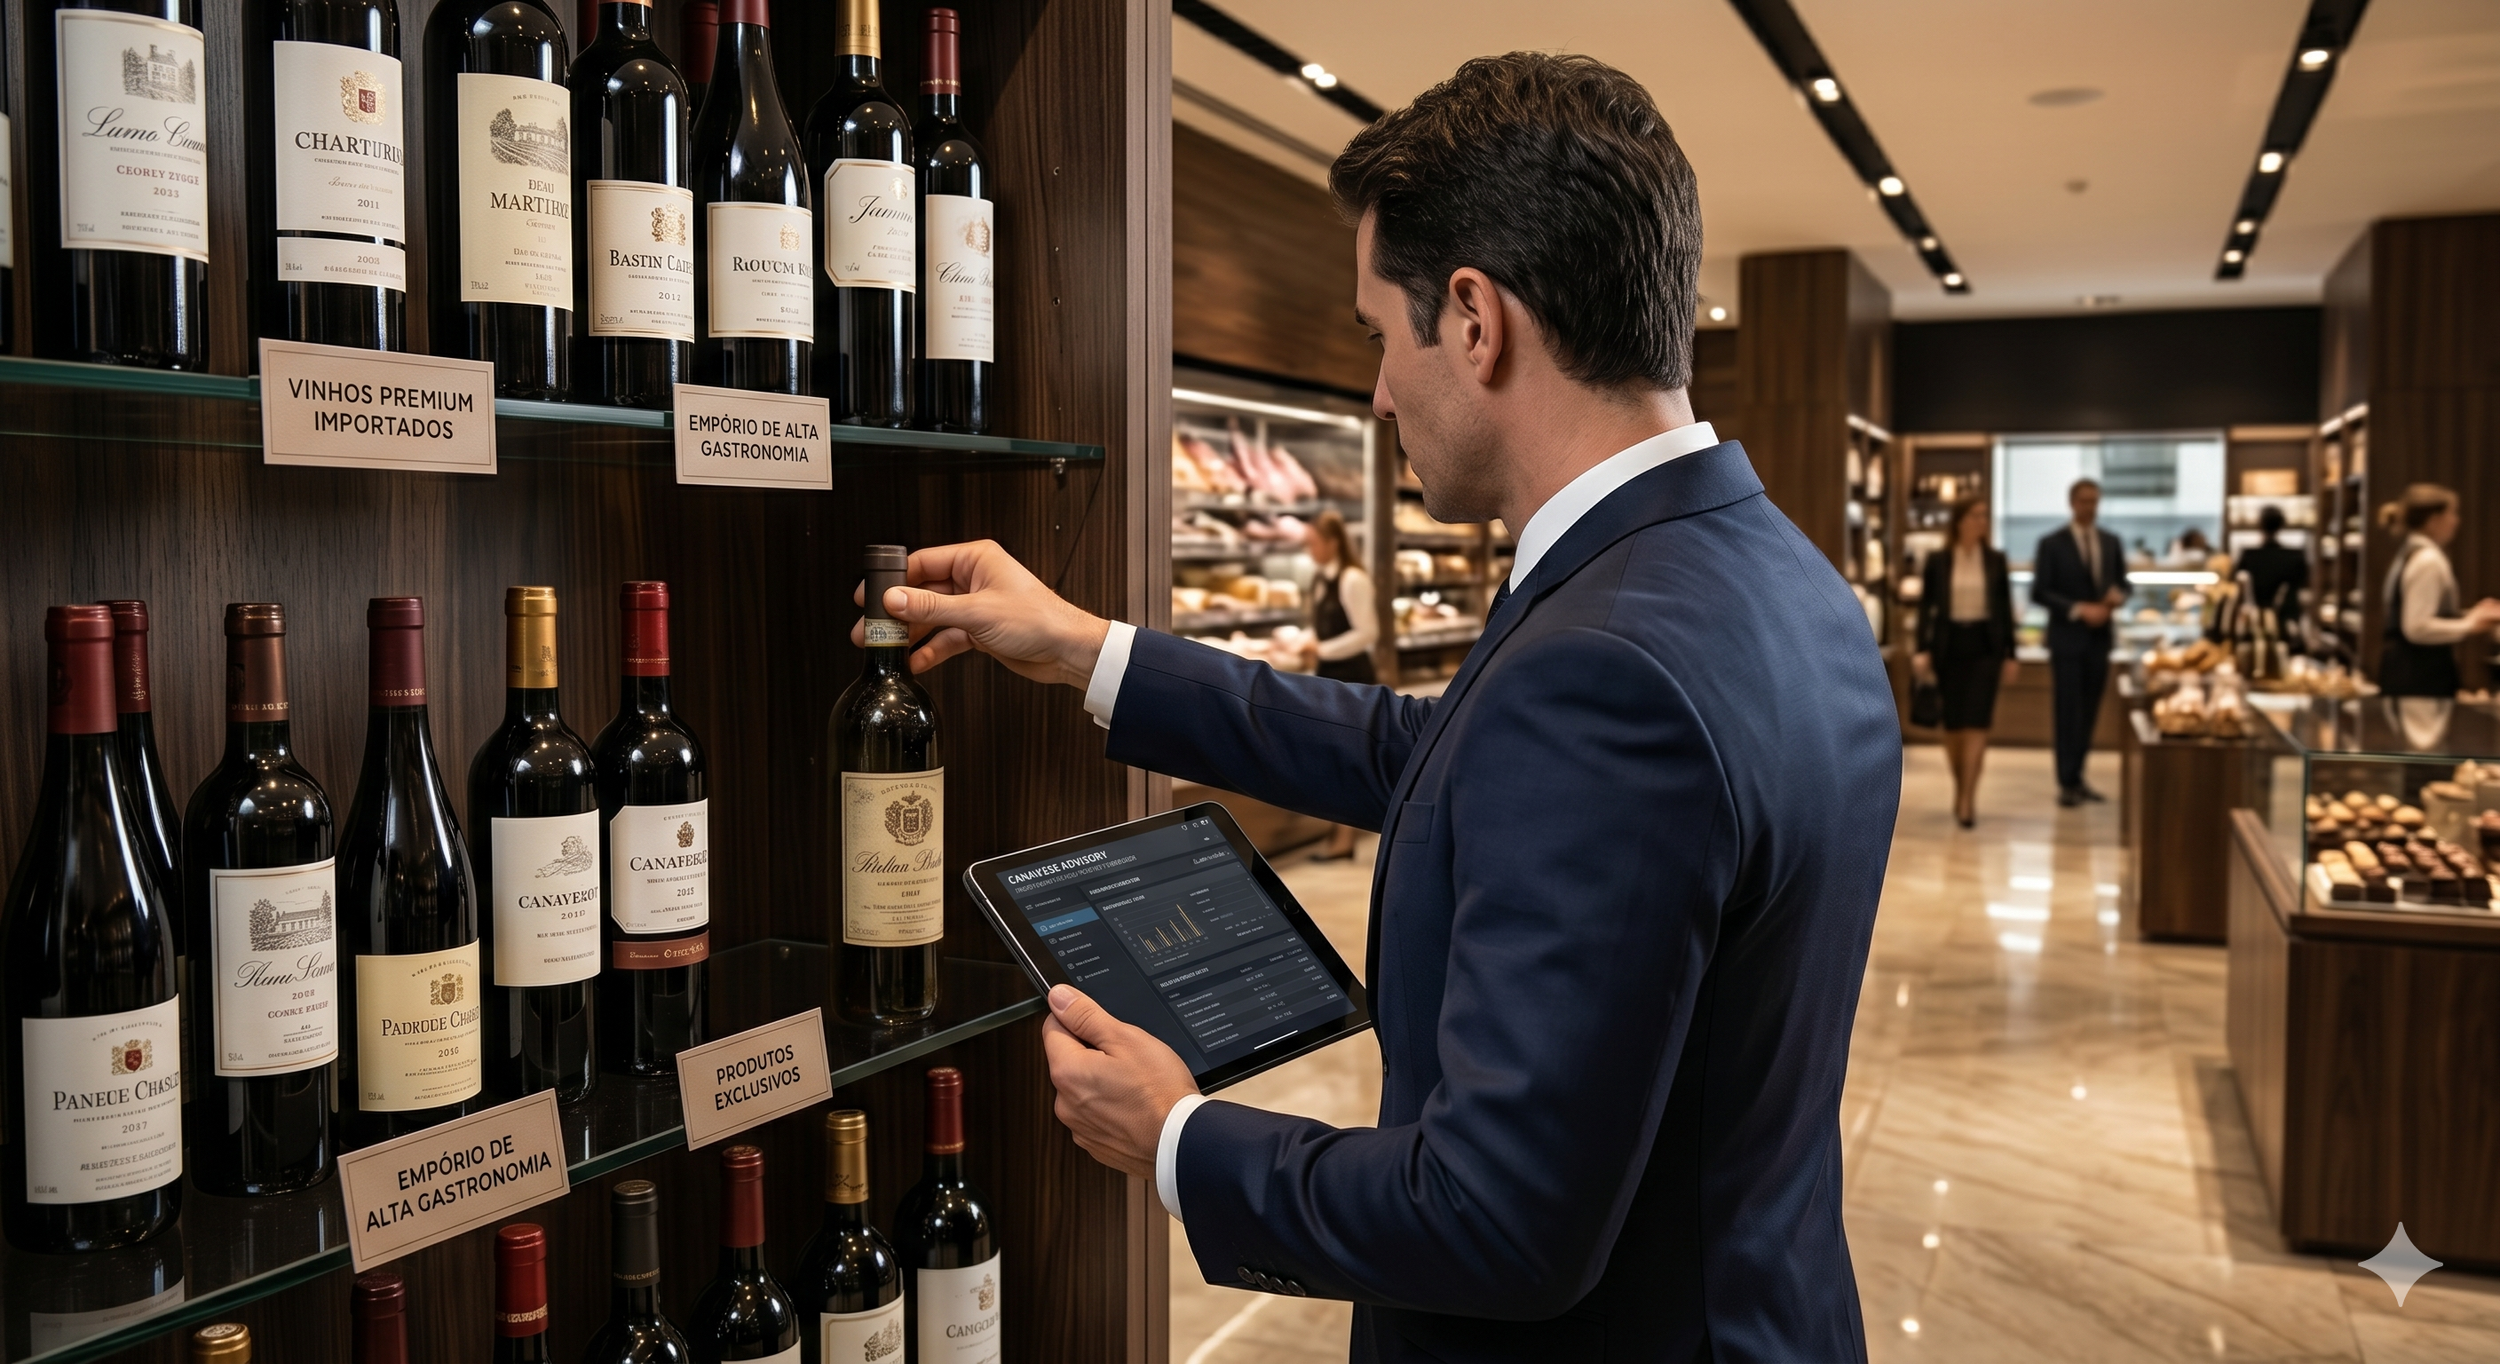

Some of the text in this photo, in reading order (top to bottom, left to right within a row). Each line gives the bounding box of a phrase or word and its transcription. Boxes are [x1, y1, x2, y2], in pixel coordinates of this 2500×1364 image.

[357, 198, 380, 210] 2011
[658, 291, 681, 302] 2012
[288, 378, 473, 412] VINHOS PREMIUM
[314, 411, 454, 440] IMPORTADOS
[762, 420, 781, 437] DE
[784, 422, 820, 440] ALTA
[701, 440, 809, 463] GASTRONOMIA
[1061, 851, 1108, 871] ADVISORY
[716, 1044, 794, 1086] PRODUTOS
[715, 1066, 801, 1111] EXCLUSIVOS
[397, 1135, 515, 1191] EMPÓRIO DE
[366, 1151, 552, 1232] ALTA GASTRONOMIA
